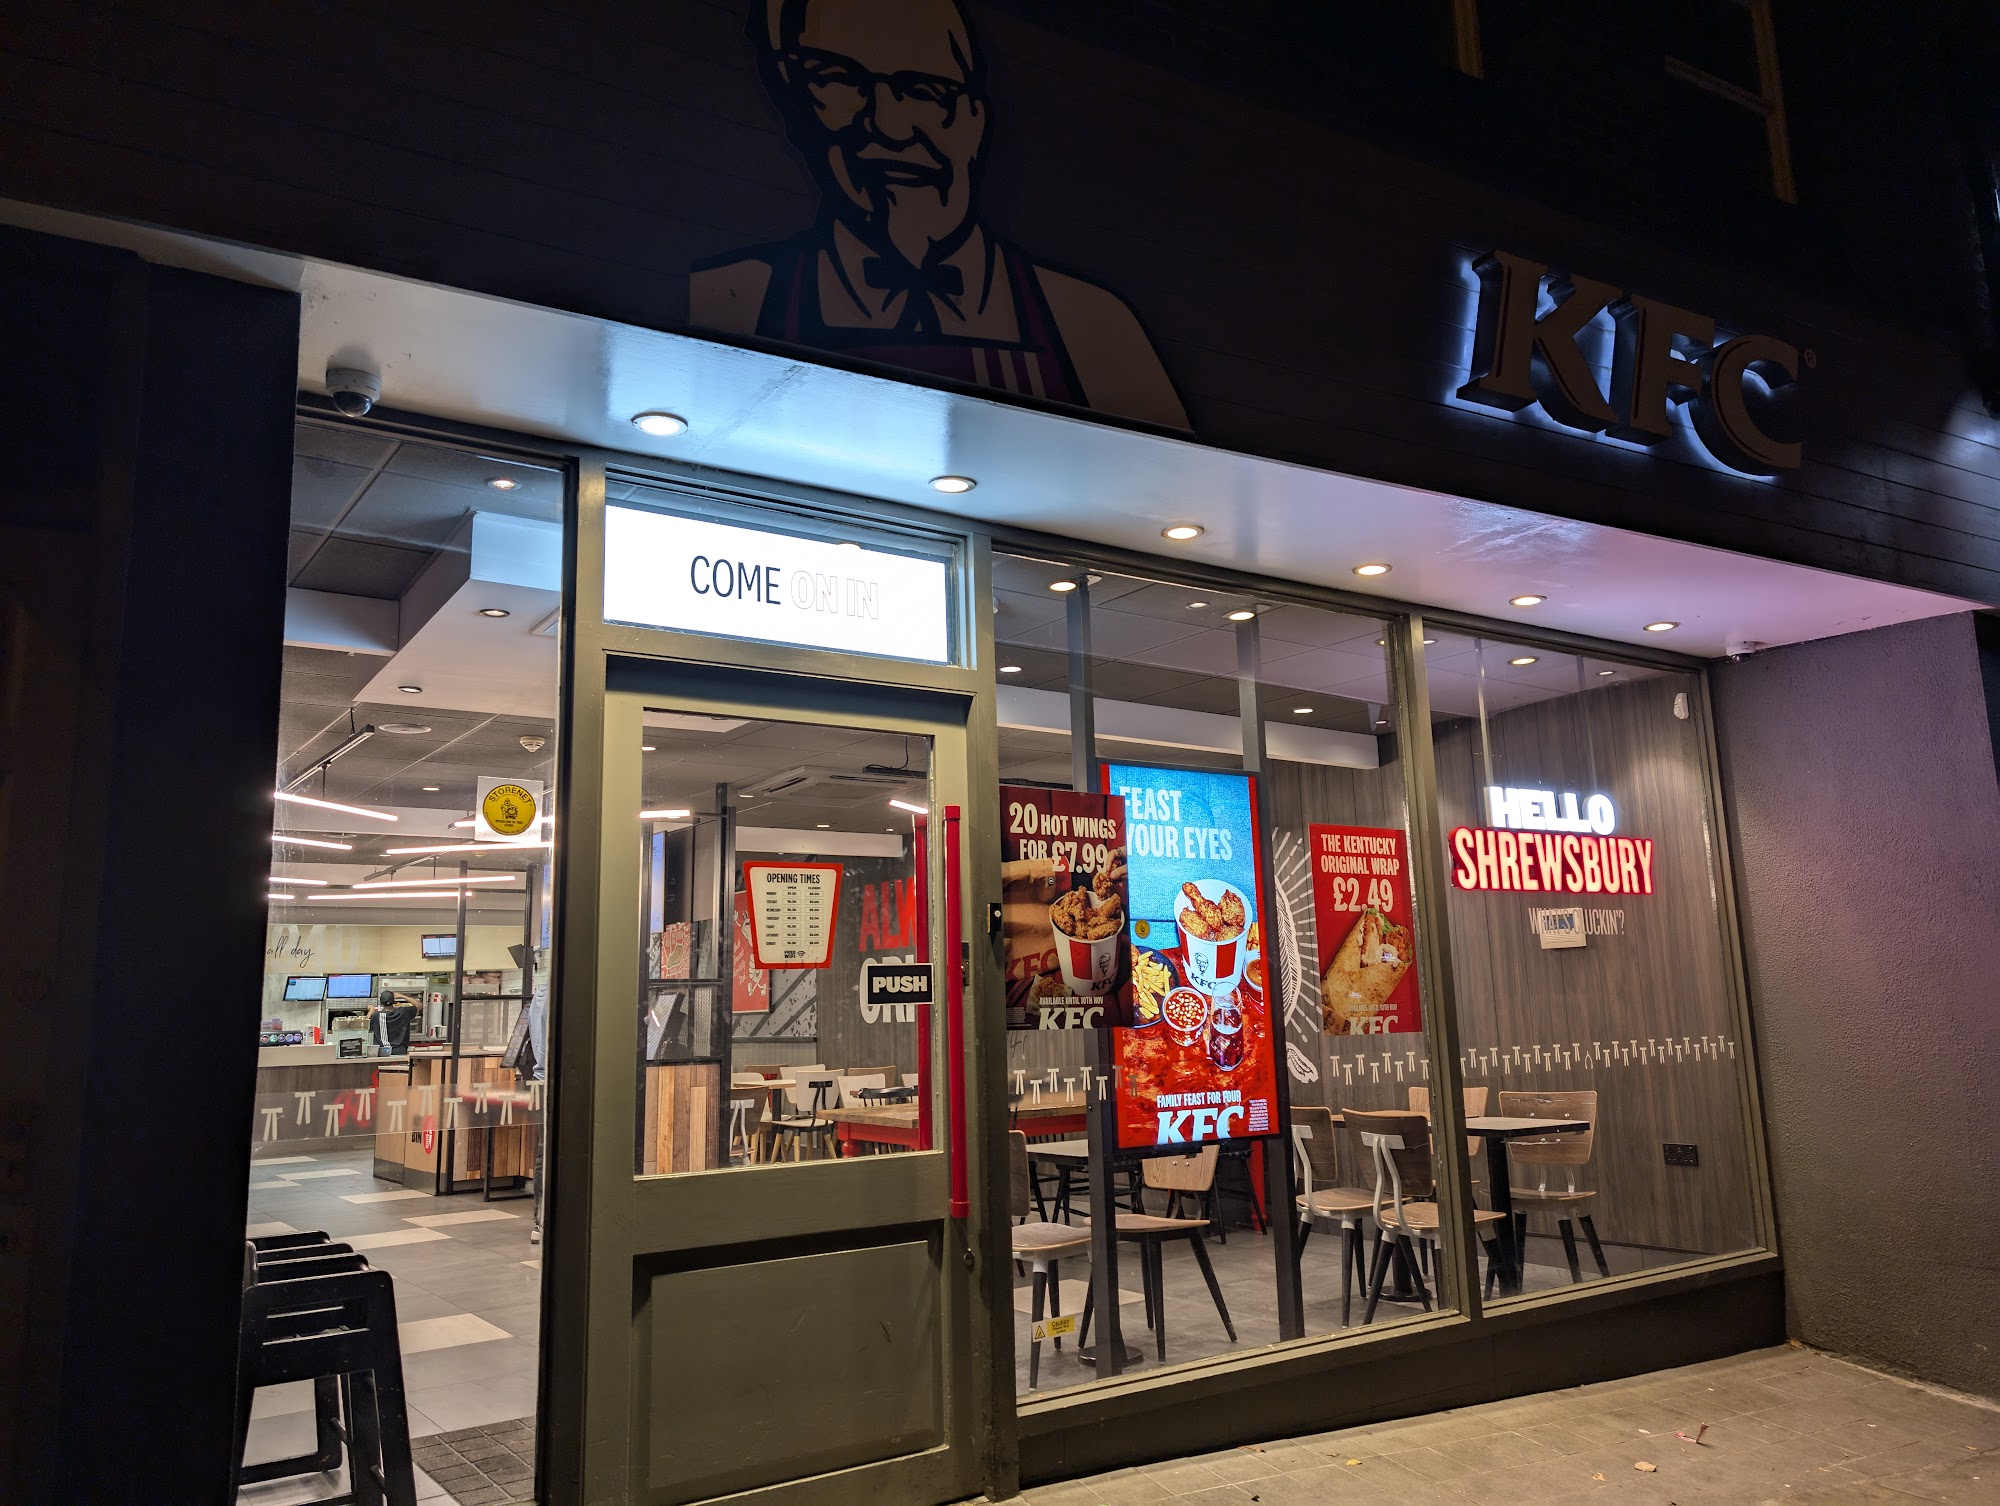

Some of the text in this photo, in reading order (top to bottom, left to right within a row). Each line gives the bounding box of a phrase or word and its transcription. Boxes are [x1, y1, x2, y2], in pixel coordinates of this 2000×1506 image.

[1463, 250, 1800, 470] KFC
[690, 555, 879, 620] COME ON IN
[488, 786, 532, 804] STORENET
[1009, 802, 1116, 839] 20 HOT WINGS
[1487, 786, 1616, 835] HELLO
[1020, 839, 1108, 873] FOR £7.99
[1127, 823, 1232, 861] YOUR EYES
[1321, 833, 1396, 856] THE KENTUCKY
[1321, 855, 1400, 876] ORIGINAL WRAP
[1453, 827, 1653, 894] SHREWSBURY
[766, 872, 821, 884] OPENING TIMES
[1332, 876, 1394, 913] £2.49
[1528, 908, 1625, 936] WHAT'S CLUCKIN'?
[267, 936, 288, 958] all
[291, 936, 315, 968] day
[872, 976, 928, 993] PUSH
[1191, 972, 1217, 991] KFC
[1039, 996, 1104, 1005] AVAILABLE UNTIL 10TH NOV
[1039, 1006, 1104, 1030] KFC
[1350, 1015, 1398, 1035] KFC
[1157, 1090, 1241, 1108] FAMILY FEAST FOR FOUR
[1157, 1106, 1244, 1144] KFC
